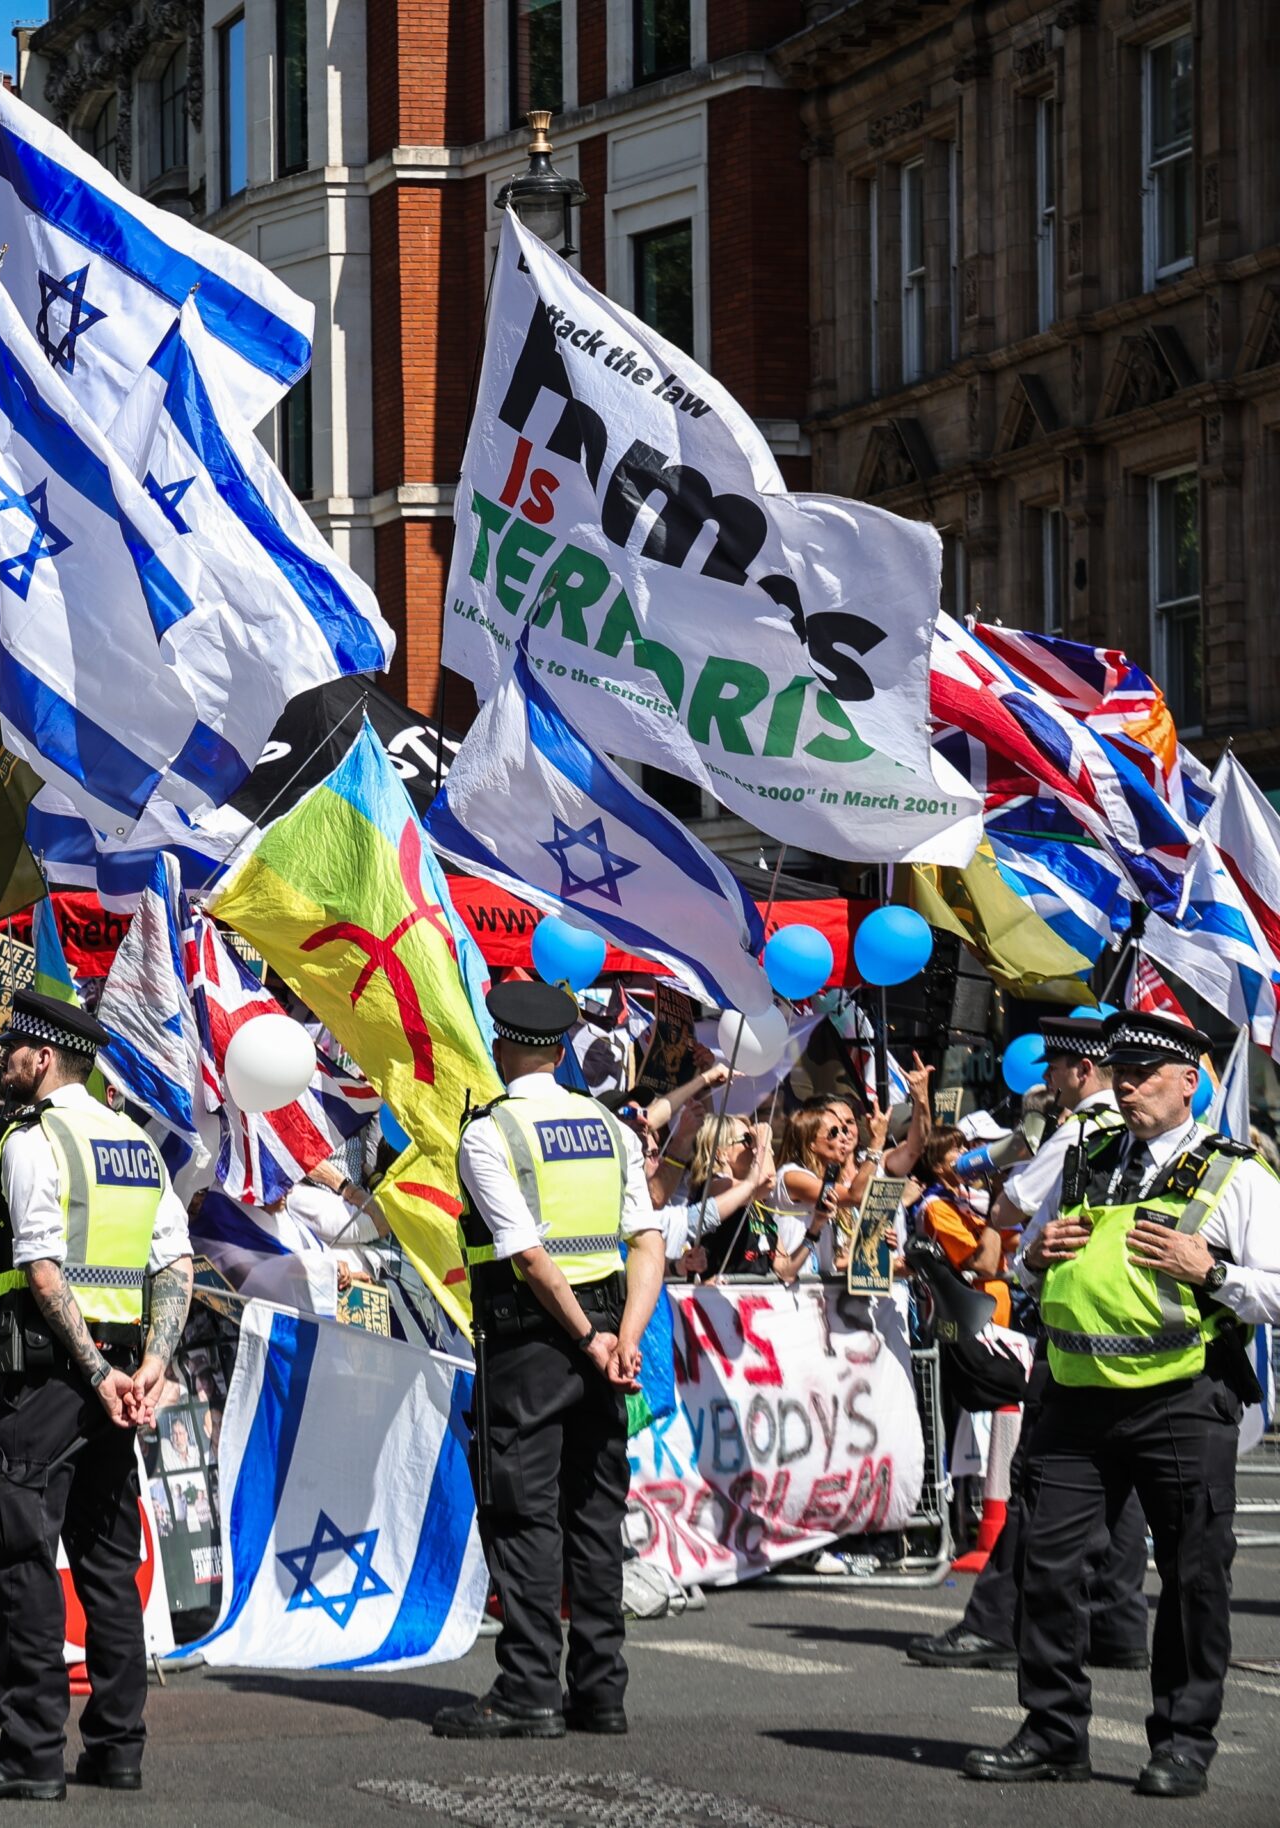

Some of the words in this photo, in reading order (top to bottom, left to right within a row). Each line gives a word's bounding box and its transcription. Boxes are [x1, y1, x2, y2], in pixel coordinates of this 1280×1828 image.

[547, 304, 607, 358] ttack
[604, 347, 653, 386] the
[652, 374, 712, 419] law
[547, 659, 567, 678] to
[571, 662, 601, 687] the
[603, 680, 673, 716] terrorist
[820, 788, 839, 804] in
[843, 790, 899, 810] March
[904, 797, 957, 816] 2001!
[2, 942, 24, 963] WE
[540, 1124, 611, 1154] POLICE
[96, 1146, 159, 1180] POLICE
